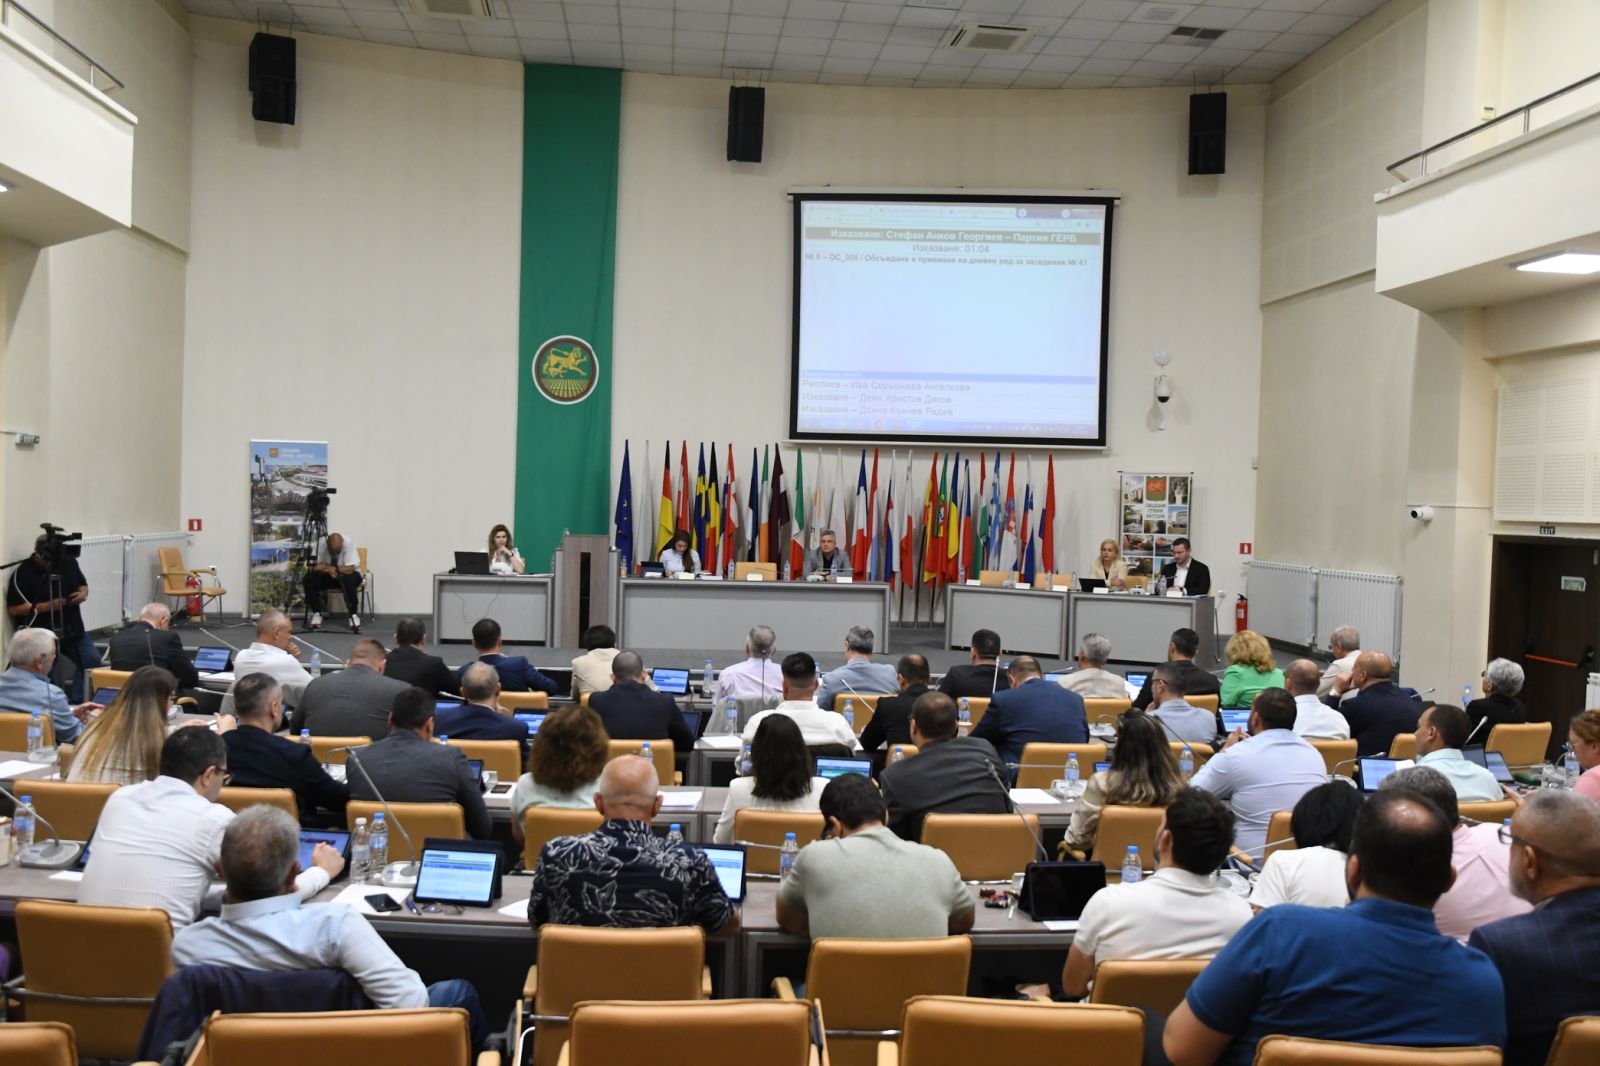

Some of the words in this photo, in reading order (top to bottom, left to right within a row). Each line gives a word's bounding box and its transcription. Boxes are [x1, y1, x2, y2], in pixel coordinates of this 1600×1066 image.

[831, 229, 884, 239] Изказване:
[886, 230, 924, 240] Стефан
[926, 231, 955, 240] Анков
[959, 232, 1002, 242] Георгиев
[1013, 233, 1048, 243] Партия
[1051, 234, 1077, 243] ГЕРБ
[964, 244, 990, 253] 01:04
[864, 254, 909, 263] Обсъждане
